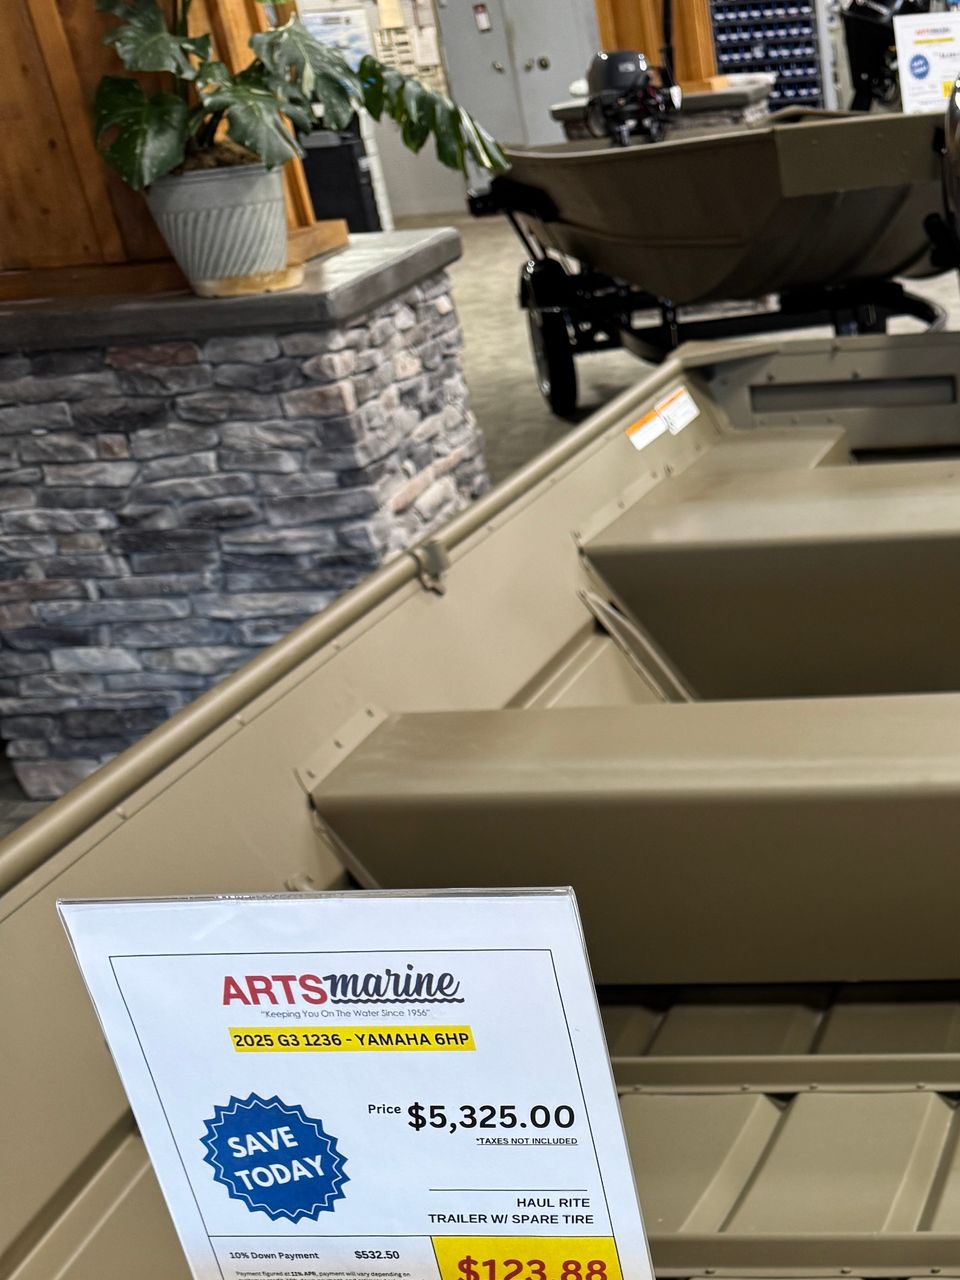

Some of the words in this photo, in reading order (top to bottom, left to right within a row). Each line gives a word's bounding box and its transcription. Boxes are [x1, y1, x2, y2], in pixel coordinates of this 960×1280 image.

[302, 1010, 319, 1018] You
[321, 1010, 334, 1018] On
[381, 1009, 404, 1017] Since
[234, 1034, 273, 1047] 2025
[278, 1034, 300, 1046] G3
[303, 1034, 341, 1046] 1236
[354, 1033, 431, 1046] YAMAHA
[434, 1032, 469, 1046] 6HP
[368, 1104, 401, 1114] Price
[407, 1101, 575, 1134] $5,325.00
[227, 1126, 298, 1158] SAVE
[234, 1155, 325, 1191] TODAY
[517, 1198, 554, 1208] HAUL
[559, 1198, 590, 1208] RITE
[428, 1213, 487, 1224] TRAILER
[491, 1213, 508, 1224] W/
[512, 1214, 558, 1224] SPARE
[563, 1214, 594, 1224] TIRE
[279, 1252, 319, 1261] Payment
[355, 1250, 400, 1260] $532.50
